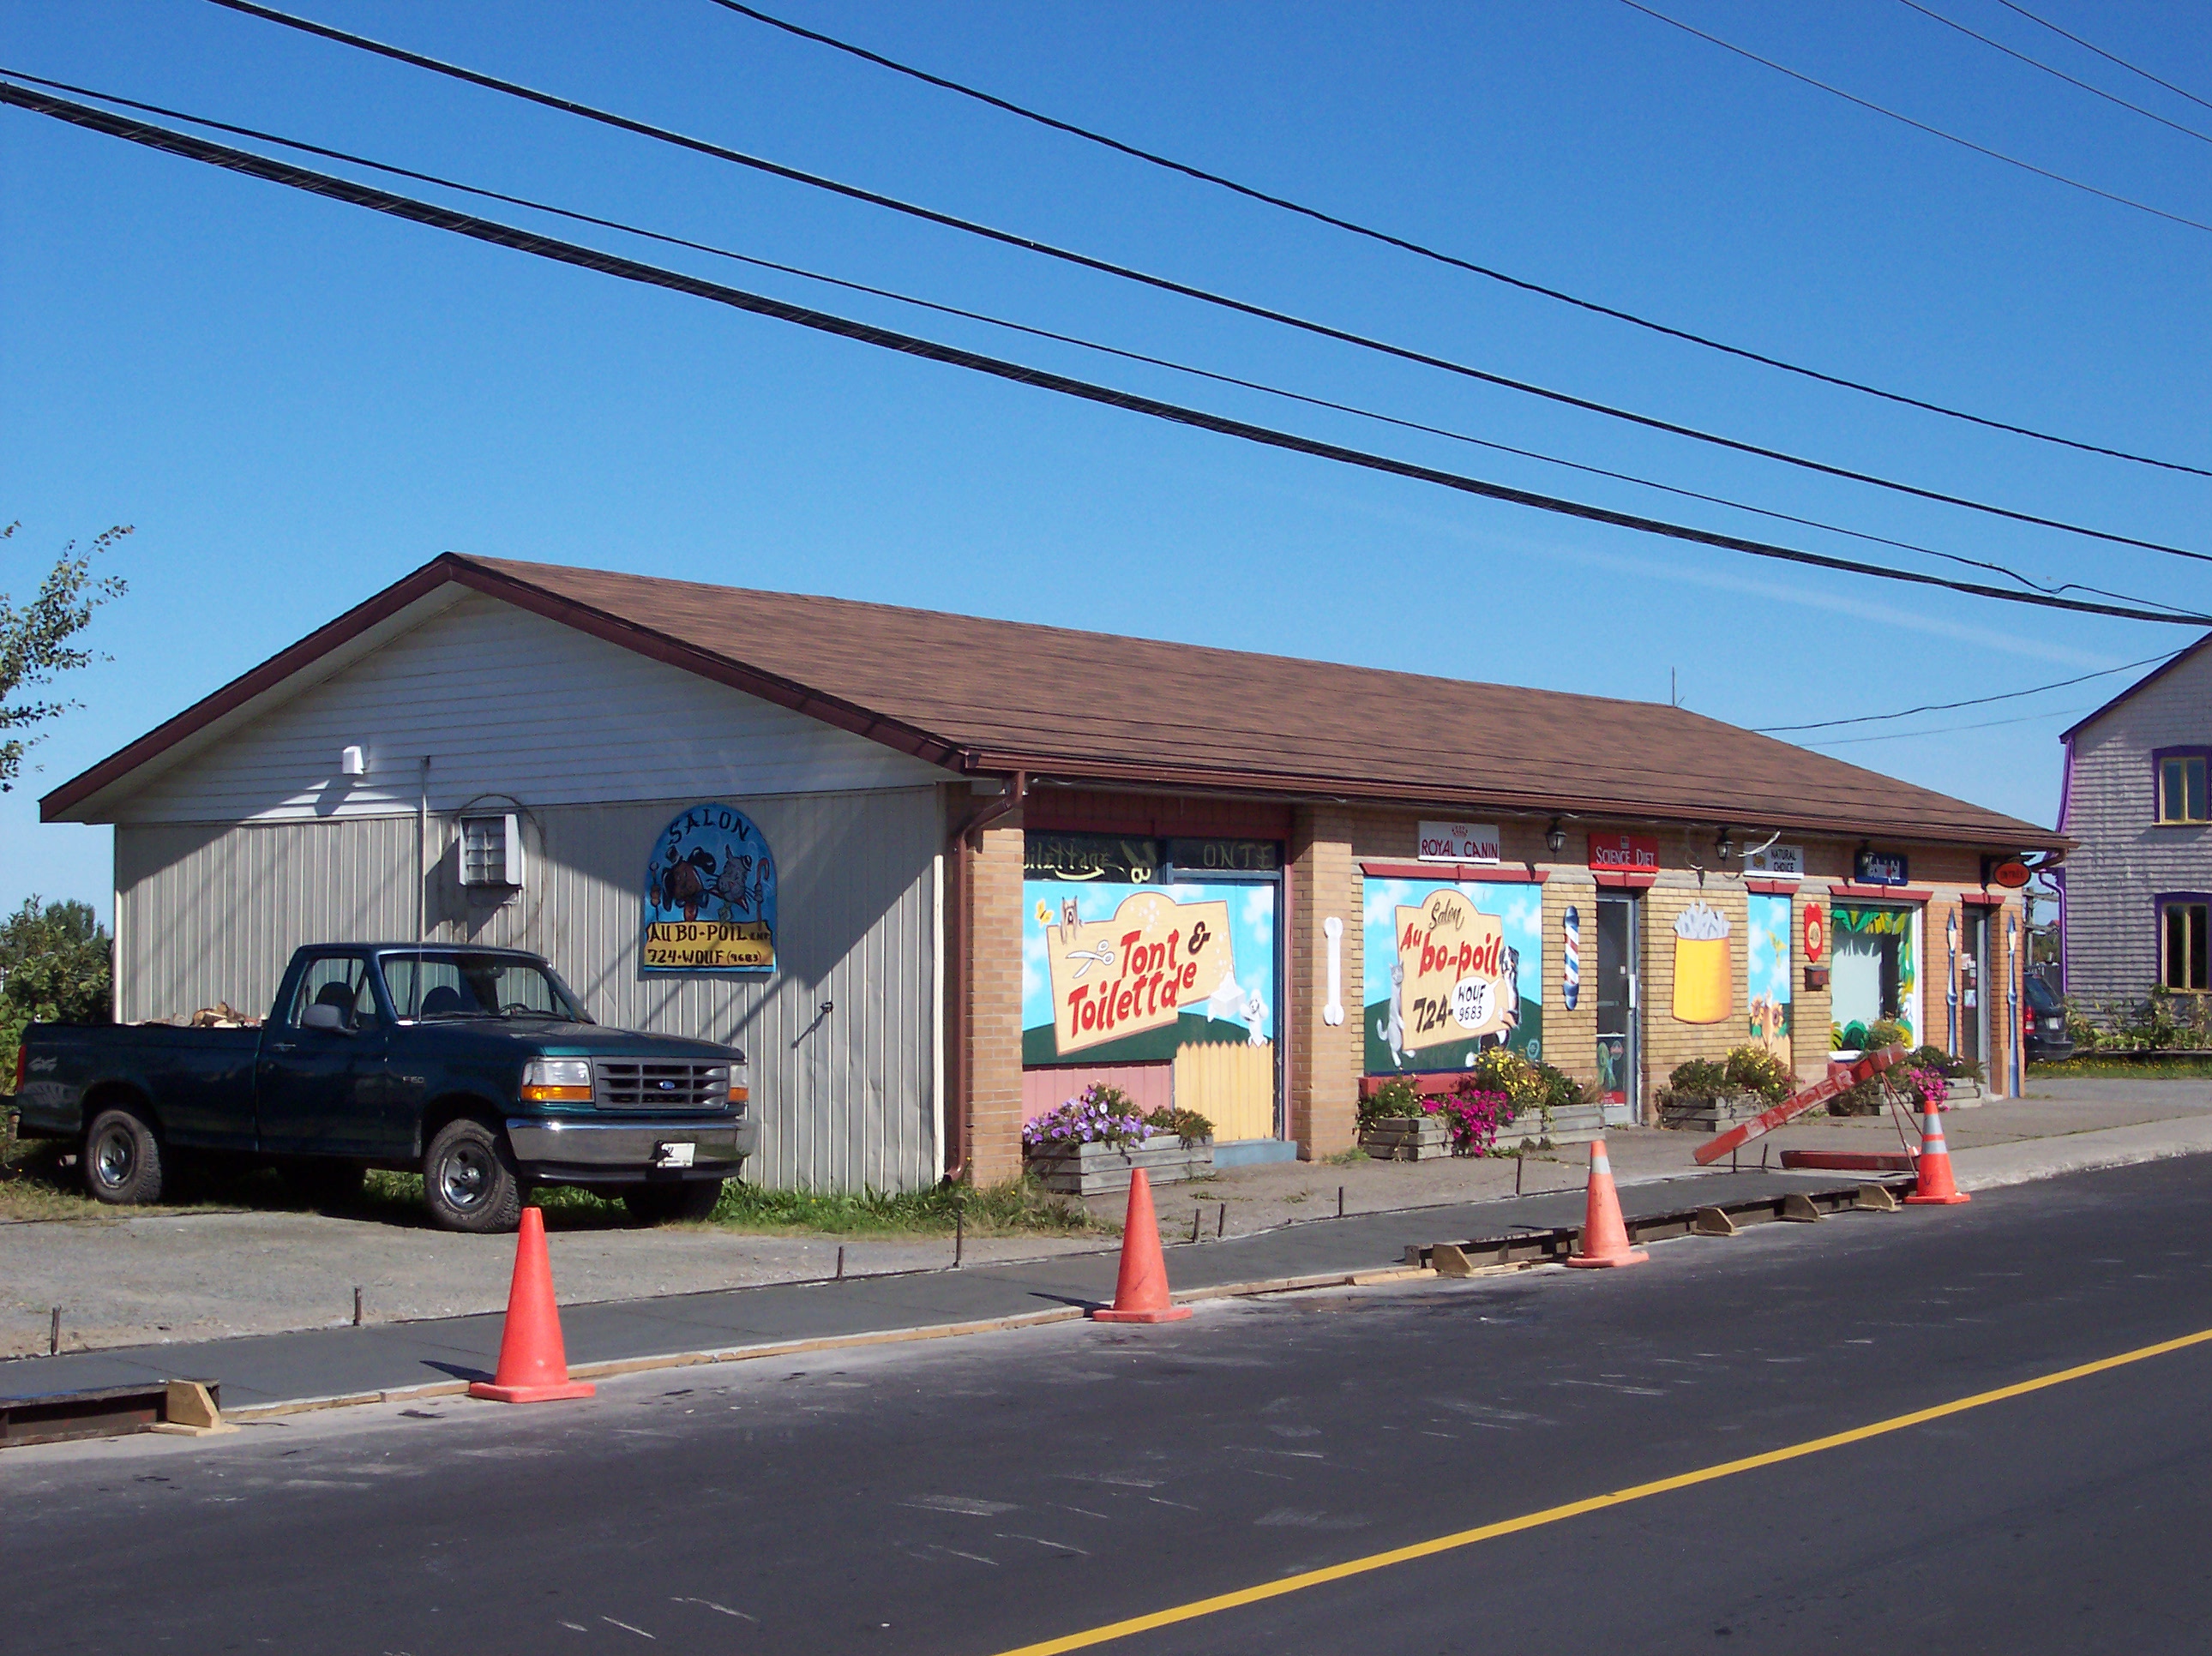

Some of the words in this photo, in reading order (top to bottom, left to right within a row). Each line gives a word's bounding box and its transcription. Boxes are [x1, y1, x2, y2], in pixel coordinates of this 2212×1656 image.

[668, 808, 751, 845] SALON
[1422, 840, 1457, 856] ROYAL
[1464, 841, 1498, 858] CANIN
[1596, 845, 1631, 865] SCIENCE
[1636, 849, 1655, 867] DIET
[1429, 898, 1464, 931] Salon
[649, 924, 671, 942] AU
[676, 924, 748, 941] BO-POIL
[1188, 921, 1211, 954] &
[1400, 923, 1422, 952] Au
[1418, 932, 1502, 983] bo-poil
